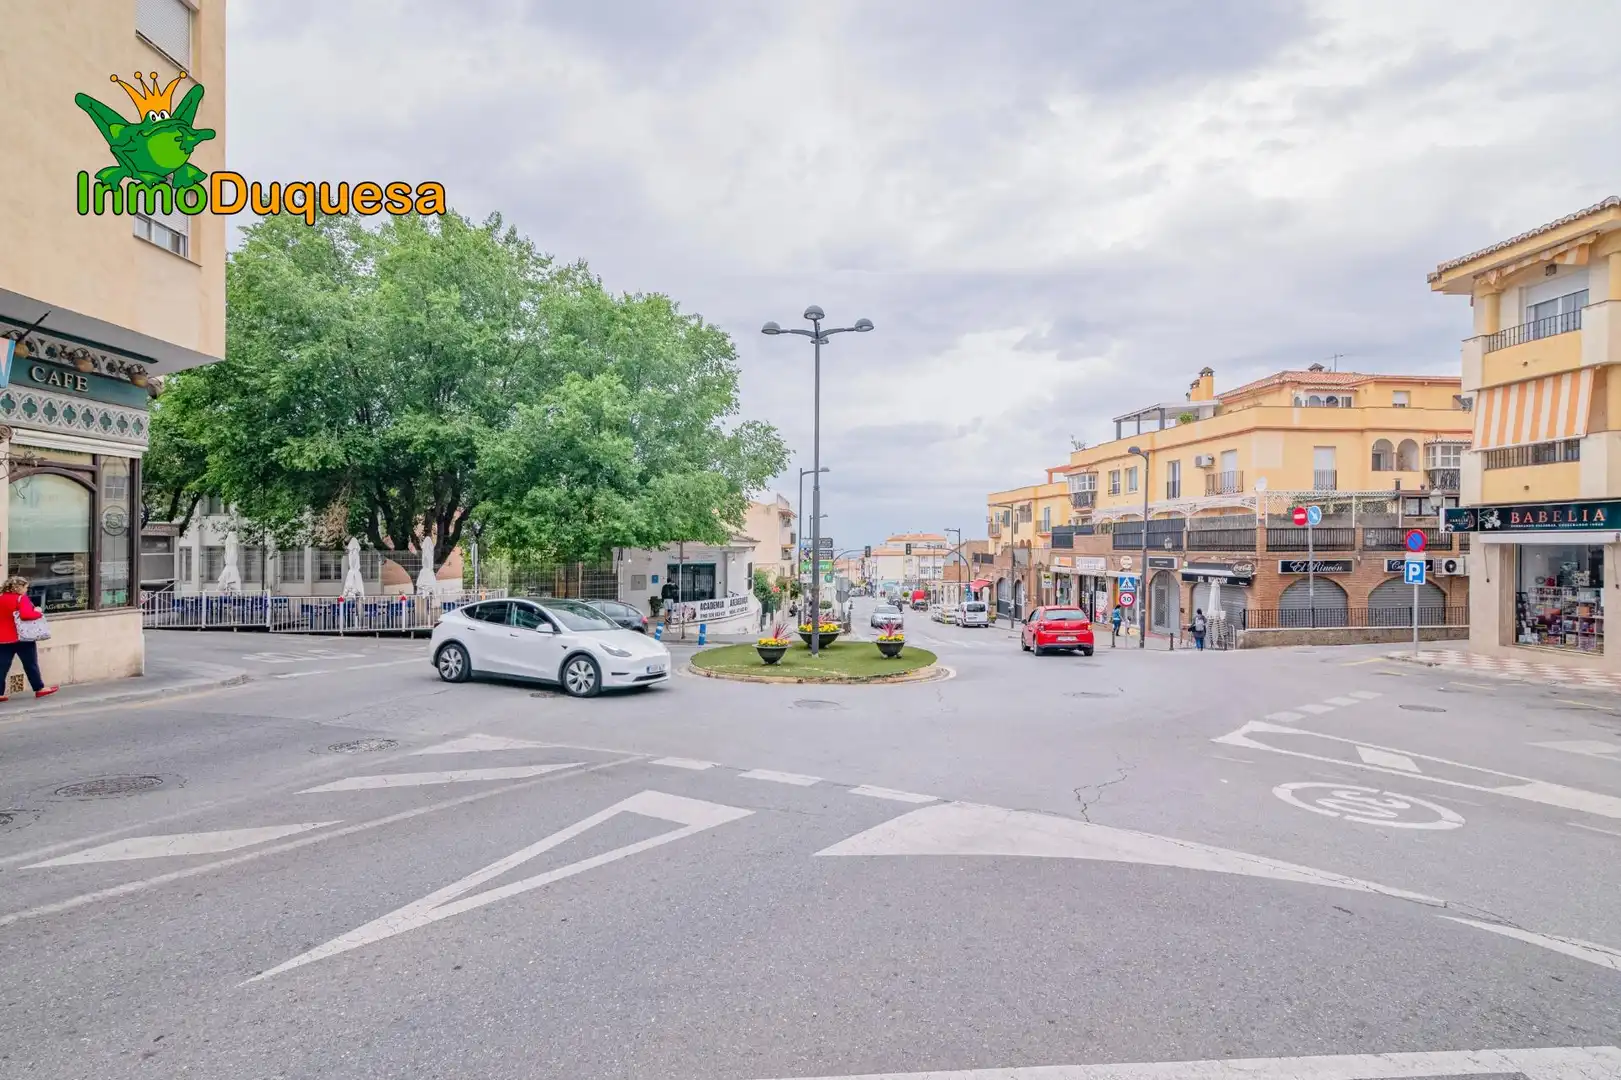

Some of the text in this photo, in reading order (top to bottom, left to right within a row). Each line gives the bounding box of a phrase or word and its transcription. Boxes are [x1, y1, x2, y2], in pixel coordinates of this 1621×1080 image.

[31, 365, 89, 392] CAFE
[1511, 508, 1606, 524] BABELIA
[1307, 561, 1343, 572] Rincón
